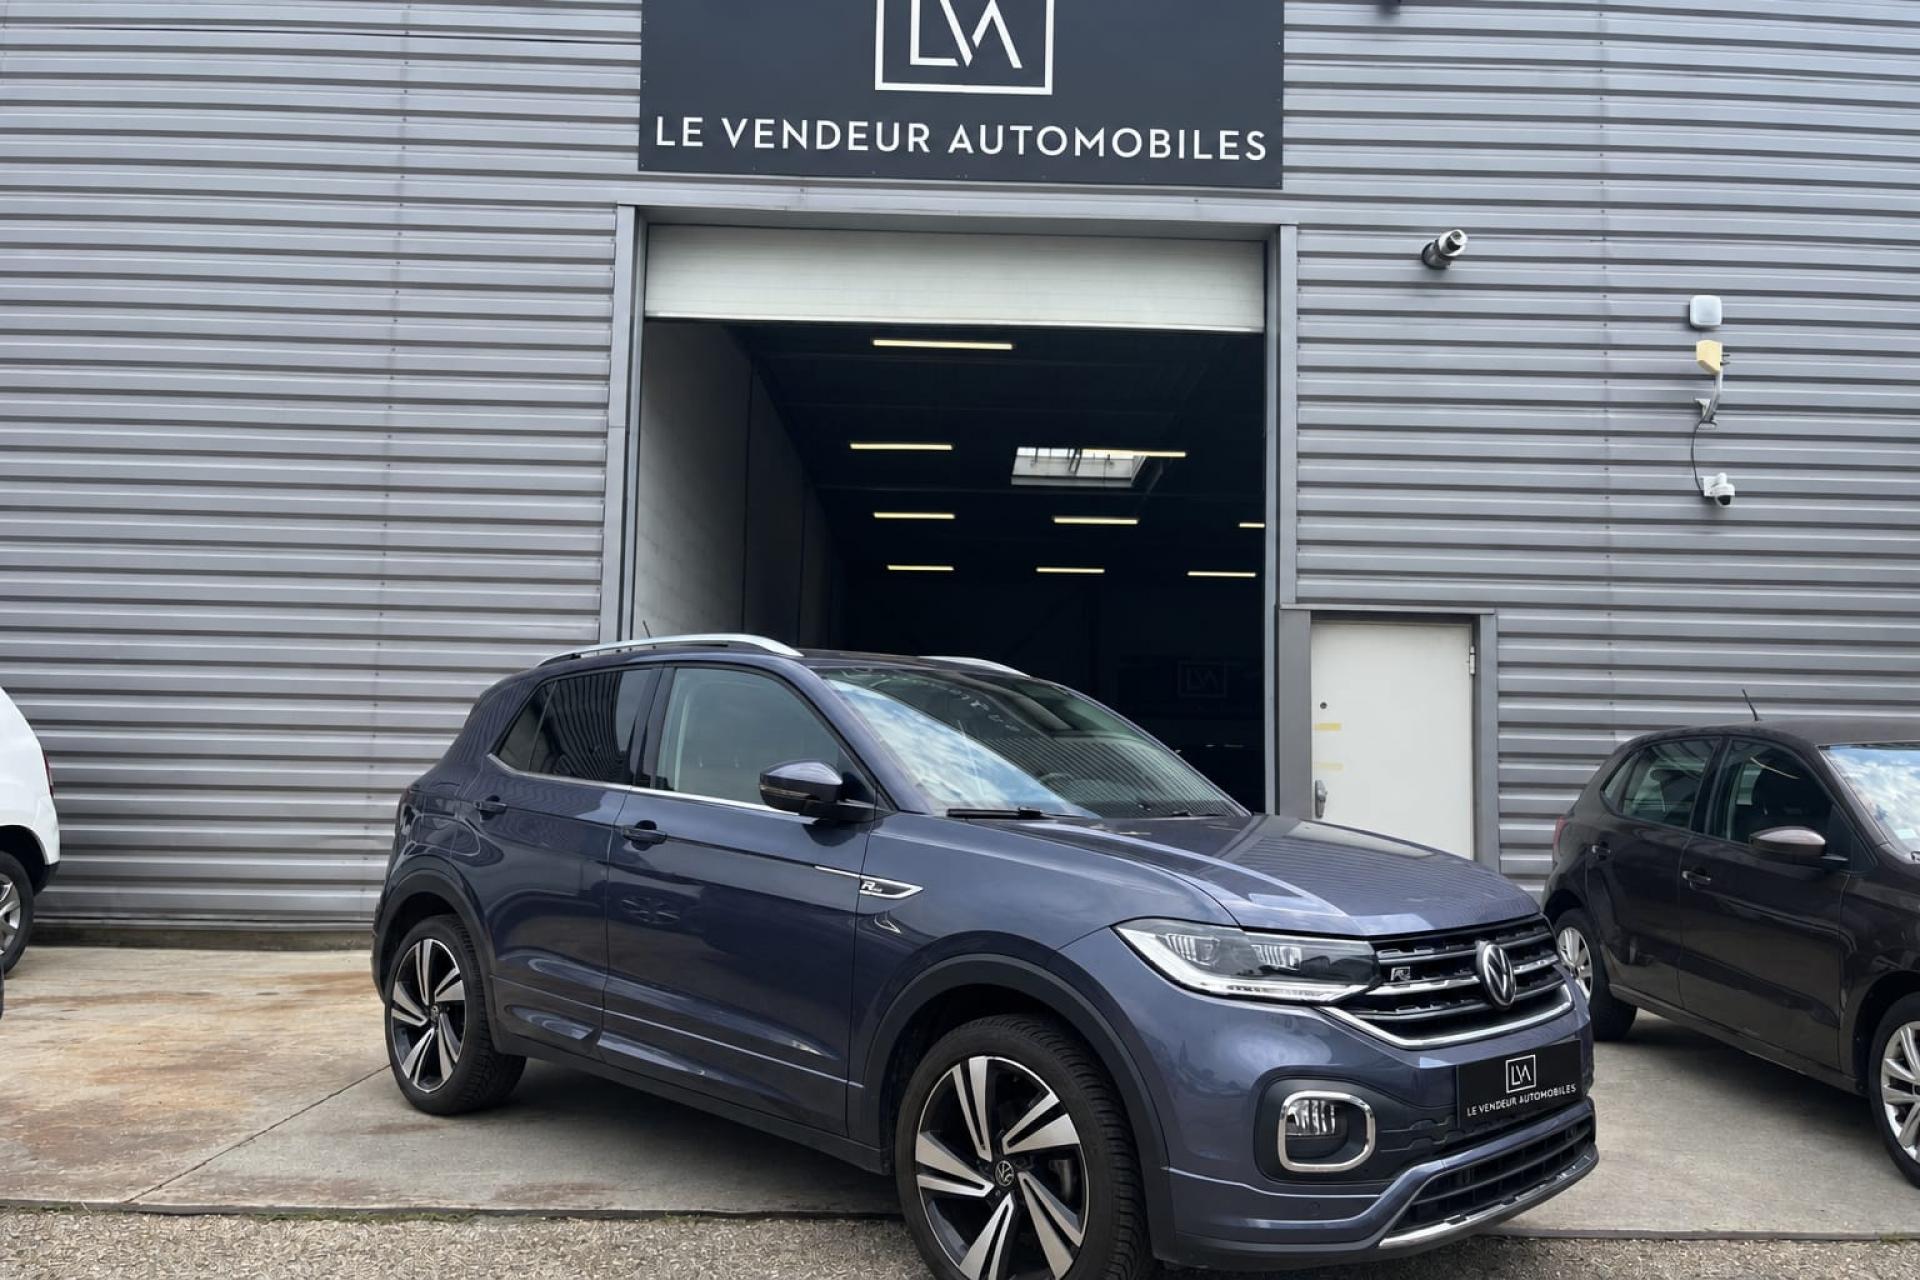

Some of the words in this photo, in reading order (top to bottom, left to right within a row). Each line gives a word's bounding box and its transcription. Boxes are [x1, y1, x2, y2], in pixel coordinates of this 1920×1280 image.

[656, 116, 704, 147] LE
[720, 117, 931, 153] VENDEUR
[947, 124, 1267, 162] AUTOMOBILES
[1466, 1106, 1478, 1117] LE
[1479, 1096, 1517, 1113] VENDEUR
[1519, 1083, 1577, 1103] AUTOMOBILES
